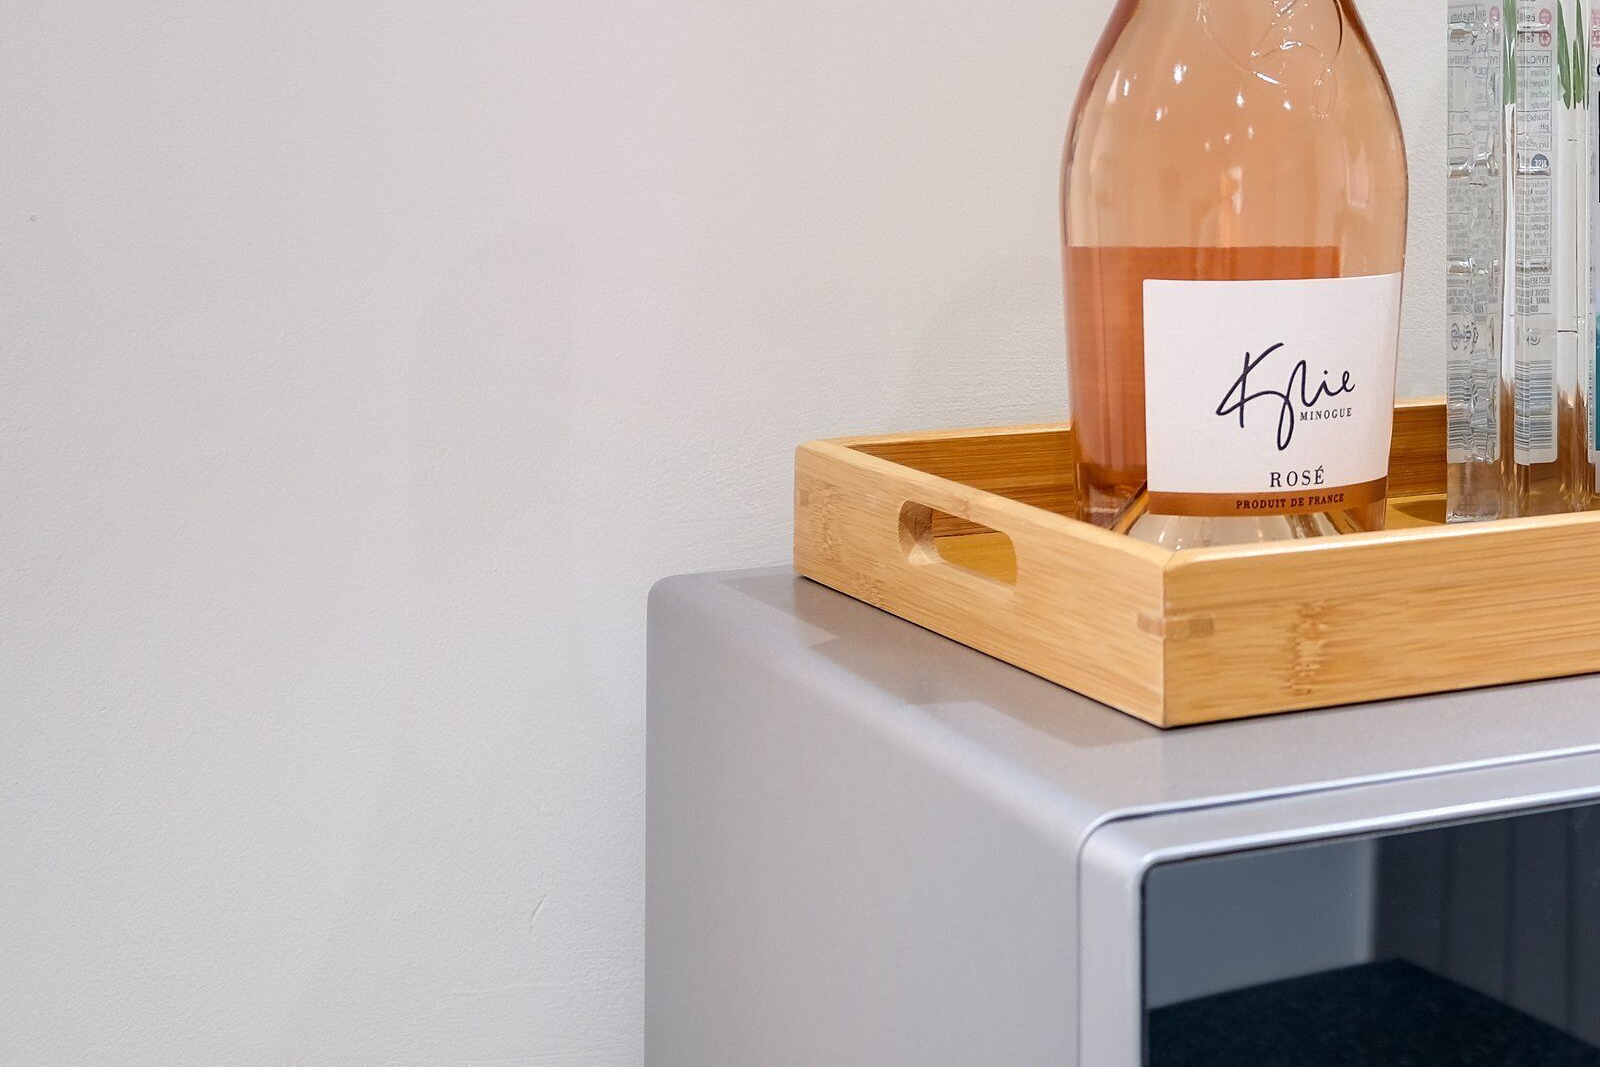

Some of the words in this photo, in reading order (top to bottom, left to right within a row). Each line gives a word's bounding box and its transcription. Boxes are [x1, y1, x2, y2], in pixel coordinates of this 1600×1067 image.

[1215, 342, 1356, 451] Kylie
[1300, 407, 1352, 421] MINOGUE
[1269, 465, 1325, 488] ROSÉ
[1236, 498, 1286, 510] PRODUIT
[1290, 497, 1305, 507] DE
[1308, 493, 1345, 505] FRANCE
